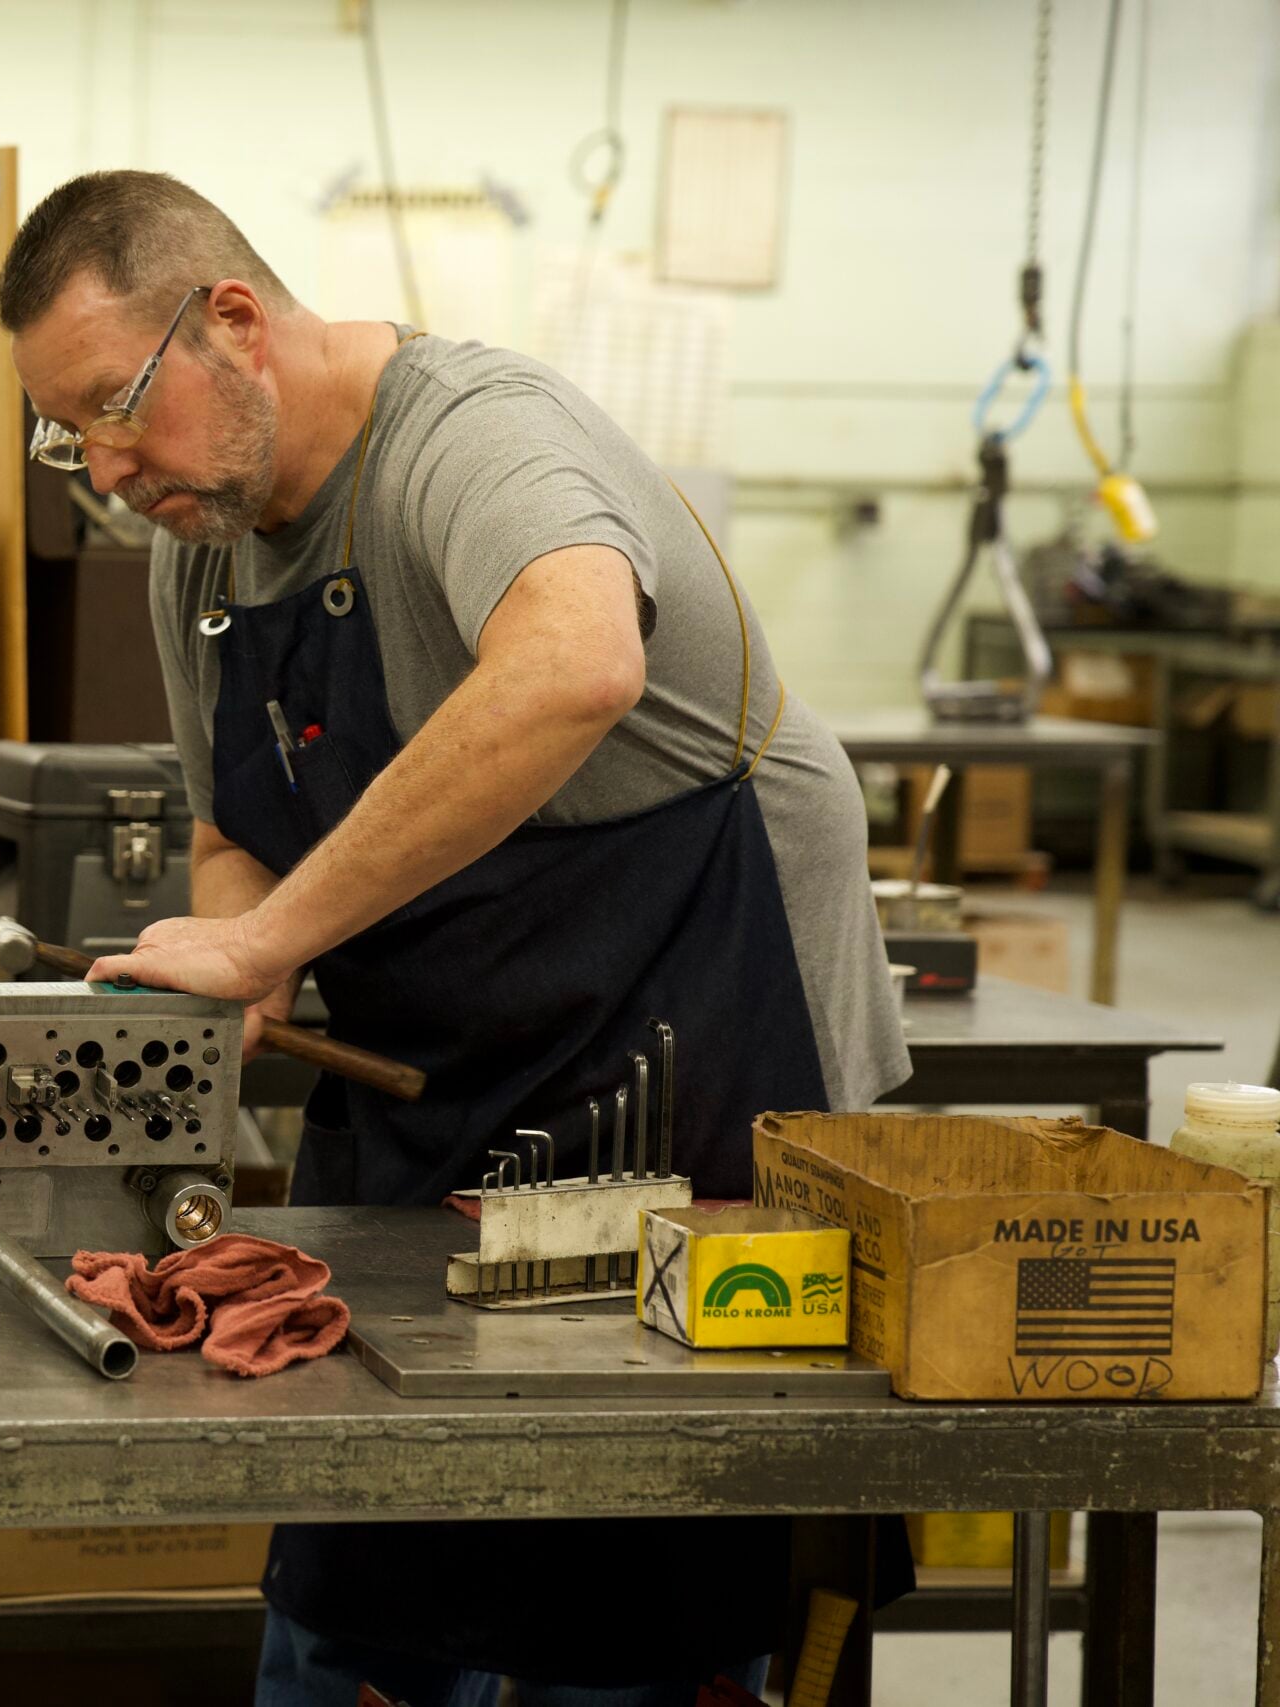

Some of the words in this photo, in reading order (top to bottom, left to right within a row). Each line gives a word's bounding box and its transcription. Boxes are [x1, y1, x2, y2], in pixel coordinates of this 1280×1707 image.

[781, 1151, 809, 1174] QUALITY
[810, 1162, 845, 1191] STAMPINGS
[816, 1188, 849, 1222] TOOL
[856, 1209, 882, 1238] AND
[993, 1218, 1084, 1243] MADE
[1095, 1218, 1129, 1243] IN
[1141, 1218, 1201, 1243] USA
[803, 1303, 841, 1315] USA
[1008, 1356, 1174, 1400] WOOD
